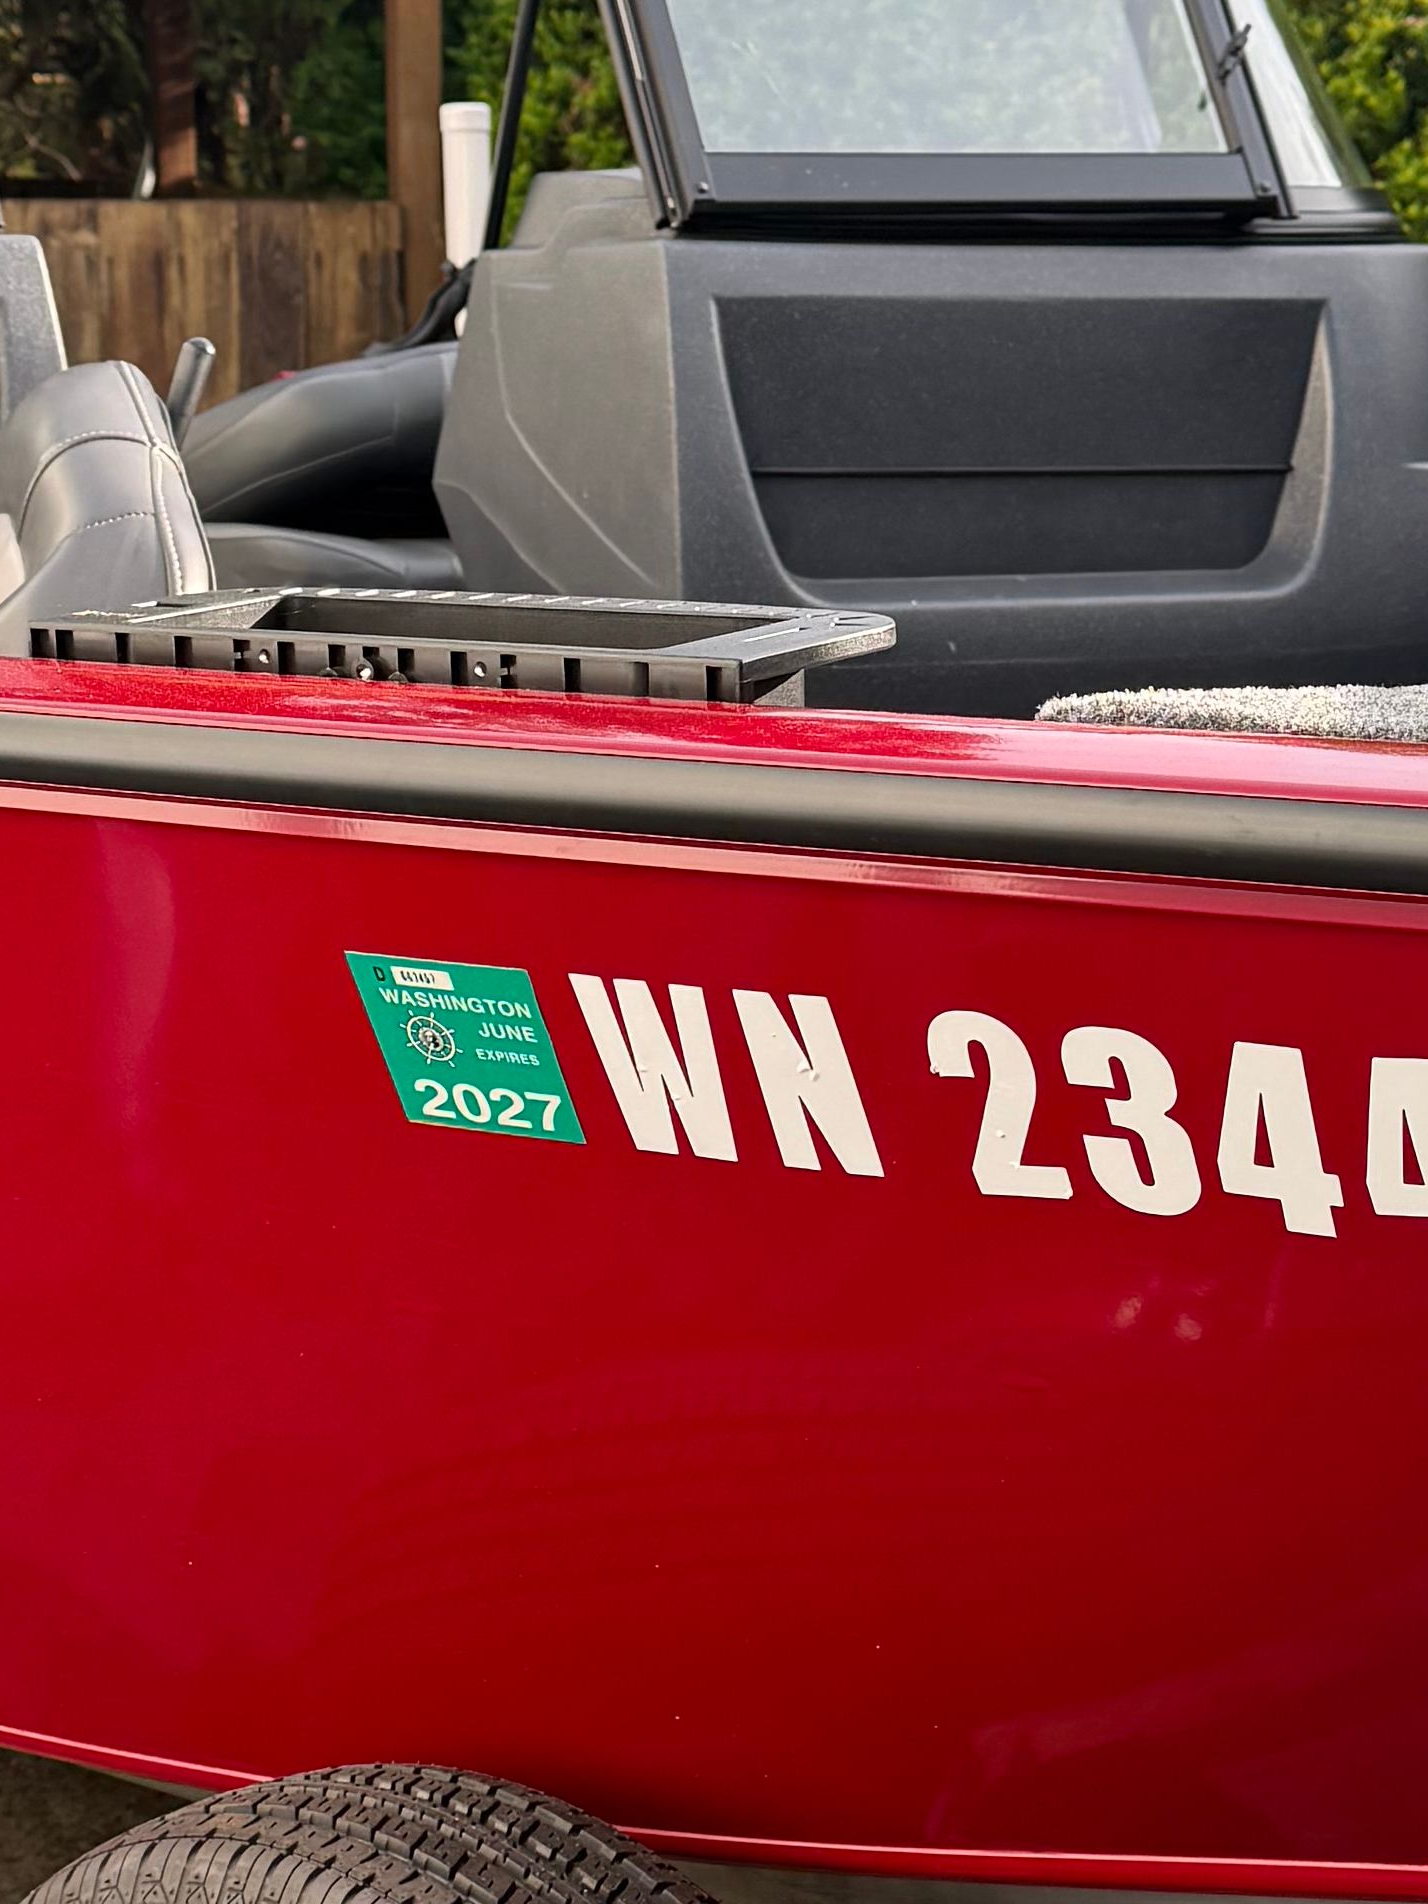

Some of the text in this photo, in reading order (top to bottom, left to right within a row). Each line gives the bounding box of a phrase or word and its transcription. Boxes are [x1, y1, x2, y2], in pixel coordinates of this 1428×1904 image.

[379, 987, 532, 1019] WASHINGTON
[478, 1022, 538, 1044] JUNE
[475, 1048, 540, 1067] EXPIRES
[568, 972, 885, 1179] WN
[413, 1078, 562, 1132] 2027
